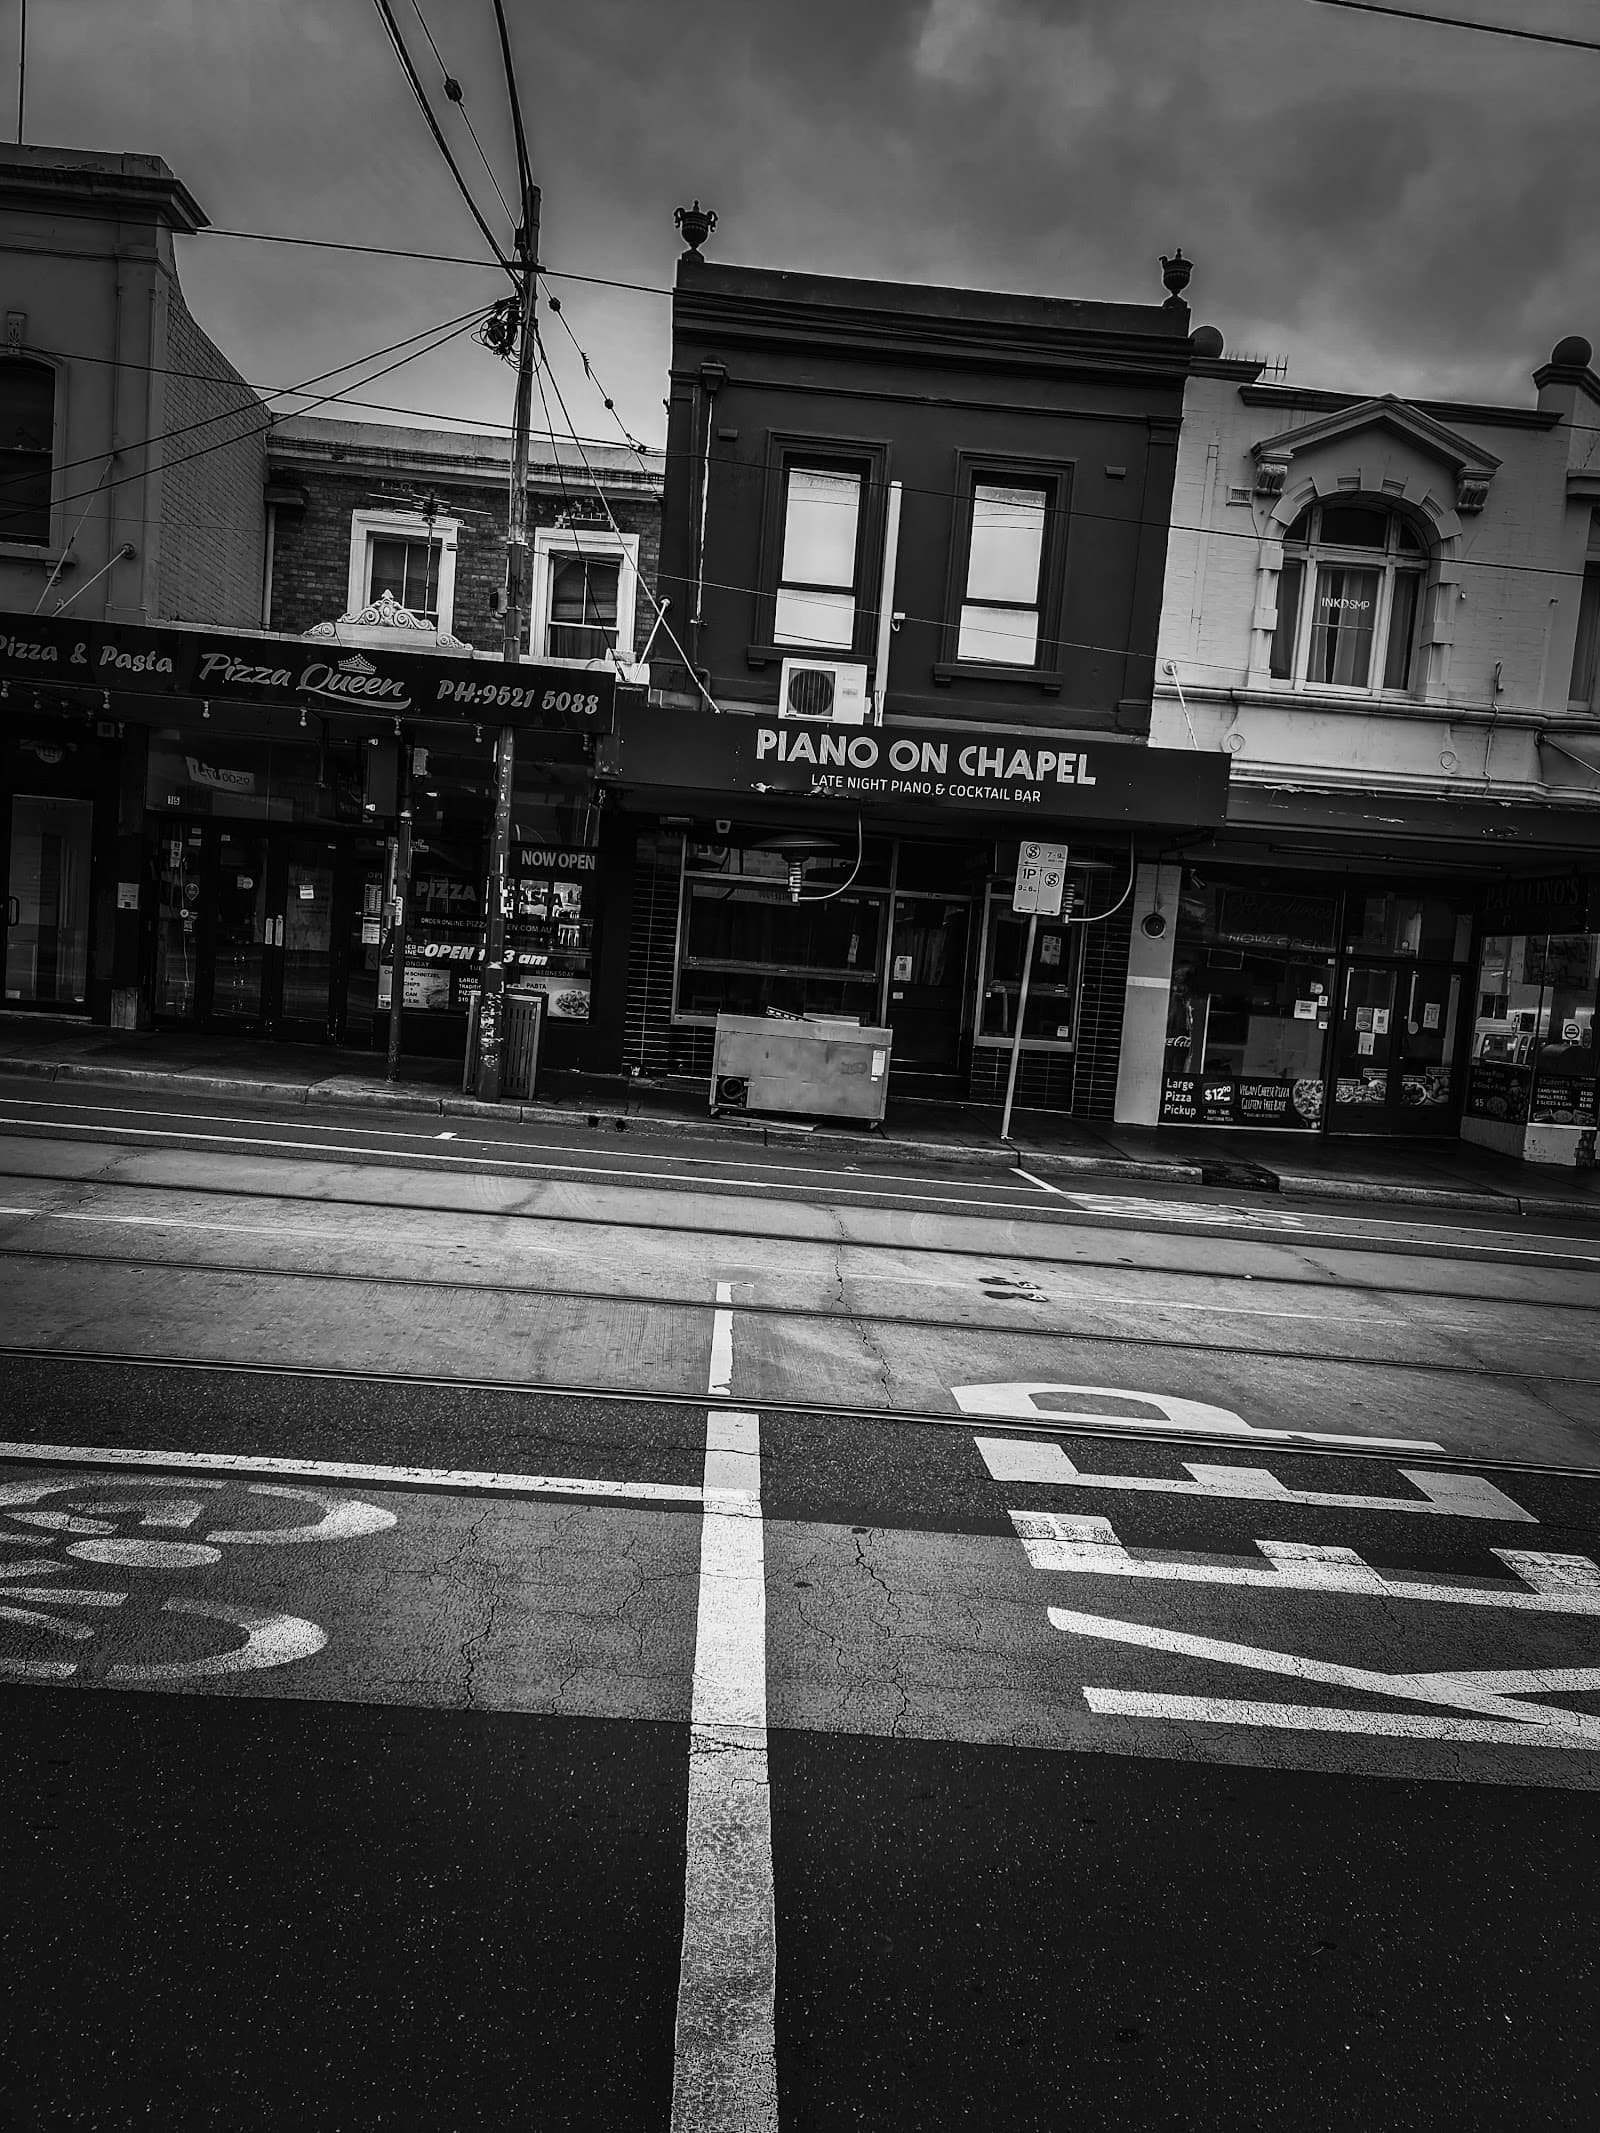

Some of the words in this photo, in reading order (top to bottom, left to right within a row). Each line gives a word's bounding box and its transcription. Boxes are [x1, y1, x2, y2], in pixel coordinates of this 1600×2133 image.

[69, 642, 88, 664] &
[99, 644, 173, 673] Pasta
[198, 652, 292, 687] Pizza
[296, 662, 410, 705] Queen
[436, 679, 536, 709] PH:9521
[541, 689, 600, 716] 5088
[755, 728, 880, 769] PIANO
[888, 739, 949, 774] ON
[958, 745, 1098, 786] CHAPEL
[811, 773, 844, 788] LATE
[847, 776, 889, 792] NIGHT
[890, 780, 931, 795] PIANO
[935, 783, 946, 796] &
[948, 784, 1011, 801] COCKTAIL
[1014, 789, 1042, 803] BAR
[521, 849, 557, 867] NOW
[557, 852, 596, 871] OPEN
[1023, 868, 1036, 880] 1P
[416, 881, 477, 902] PIZZA
[424, 943, 476, 960] OPEN
[518, 953, 549, 966] am
[535, 969, 575, 977] WEDNESDAY
[1166, 1077, 1195, 1092] Large
[1164, 1090, 1192, 1102] Pizza
[1163, 1103, 1197, 1118] Pickup
